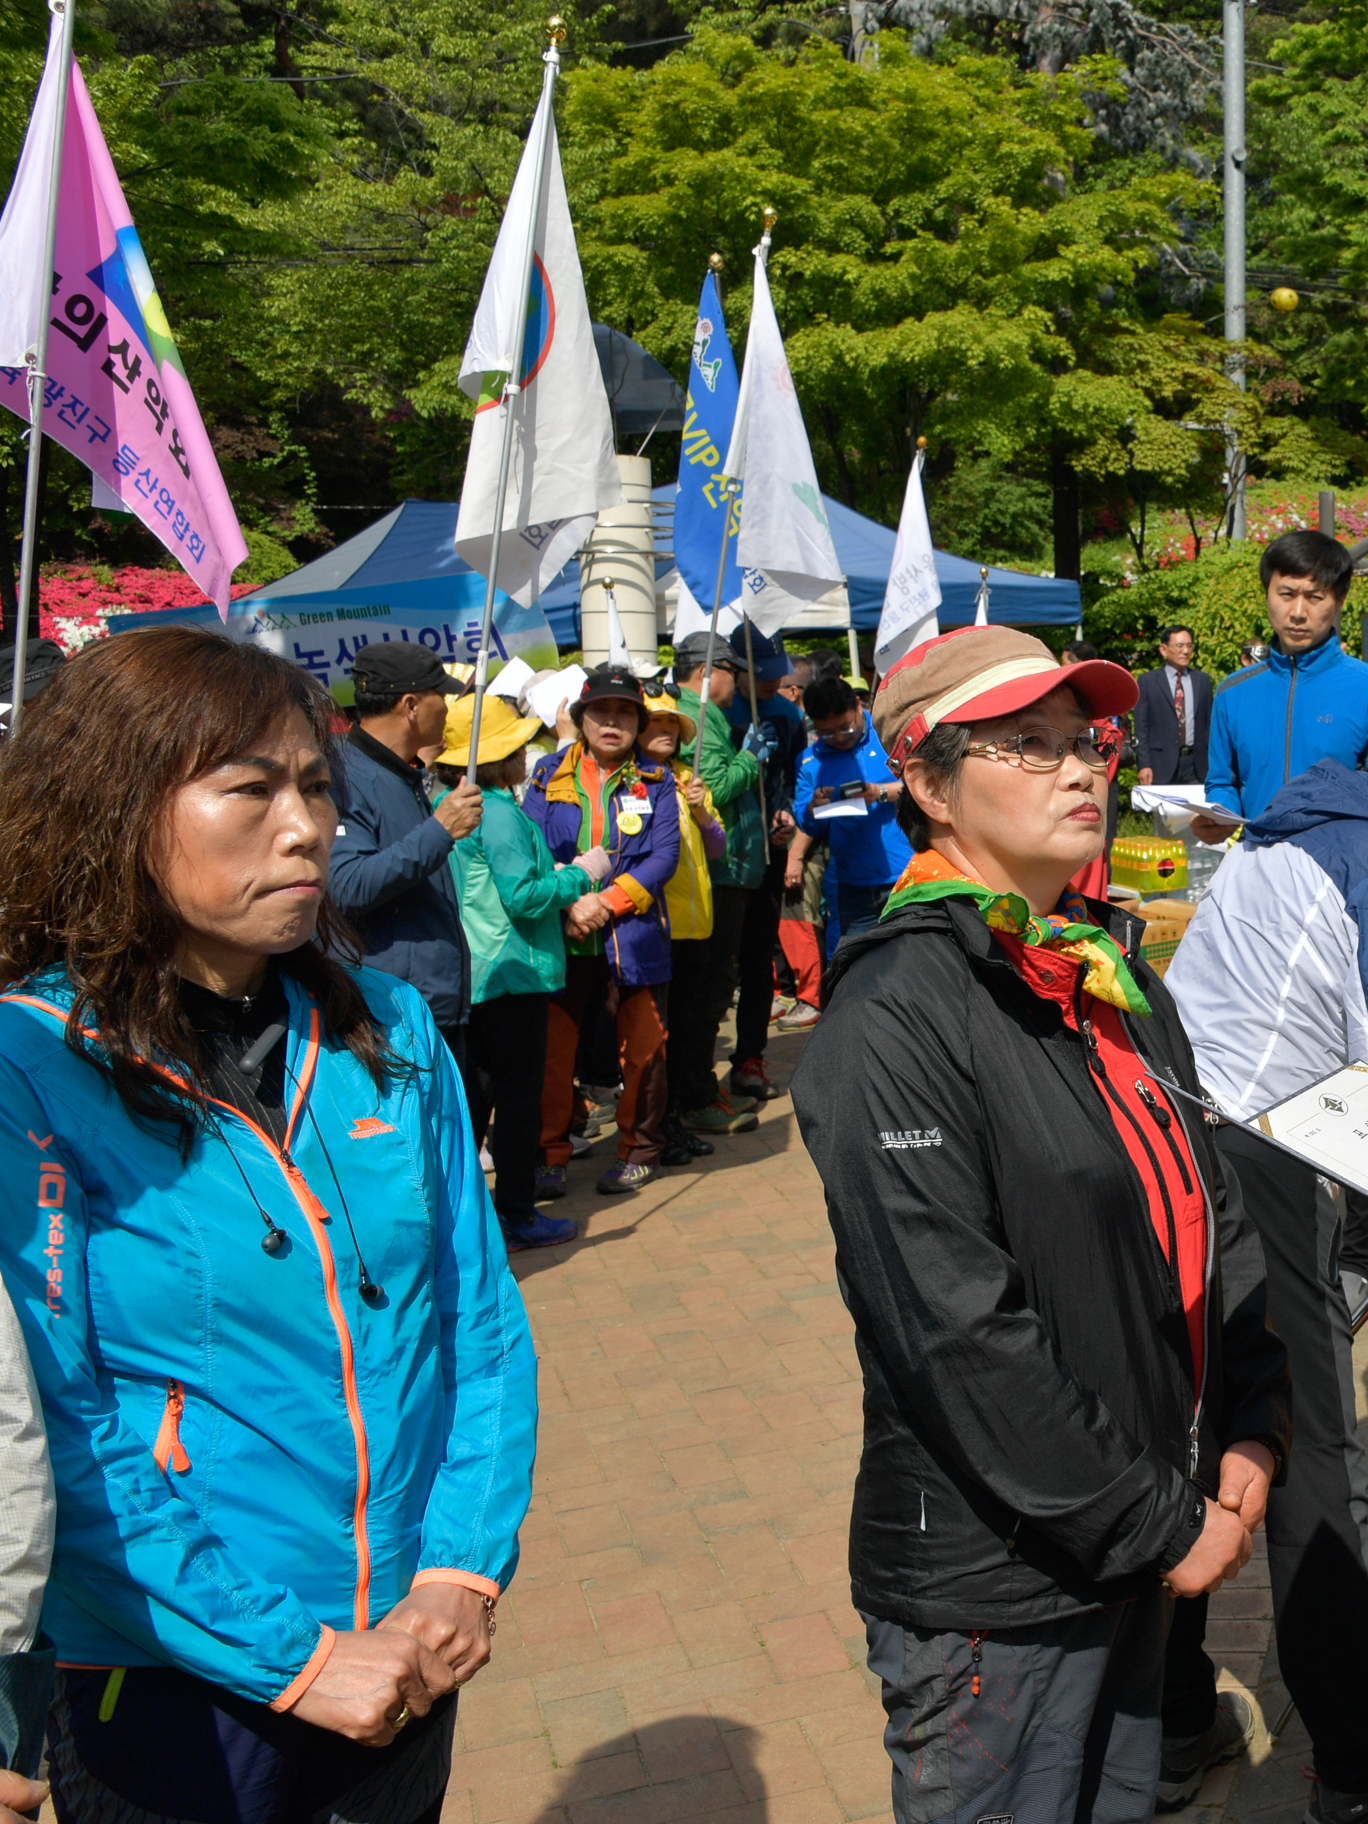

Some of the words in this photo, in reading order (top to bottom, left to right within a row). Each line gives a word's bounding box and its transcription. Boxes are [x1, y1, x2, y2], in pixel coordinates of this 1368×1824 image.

[112, 443, 206, 565] 등산연합회
[299, 610, 334, 626] Green
[336, 602, 391, 622] Mountain
[348, 1124, 395, 1140] TRESPASS
